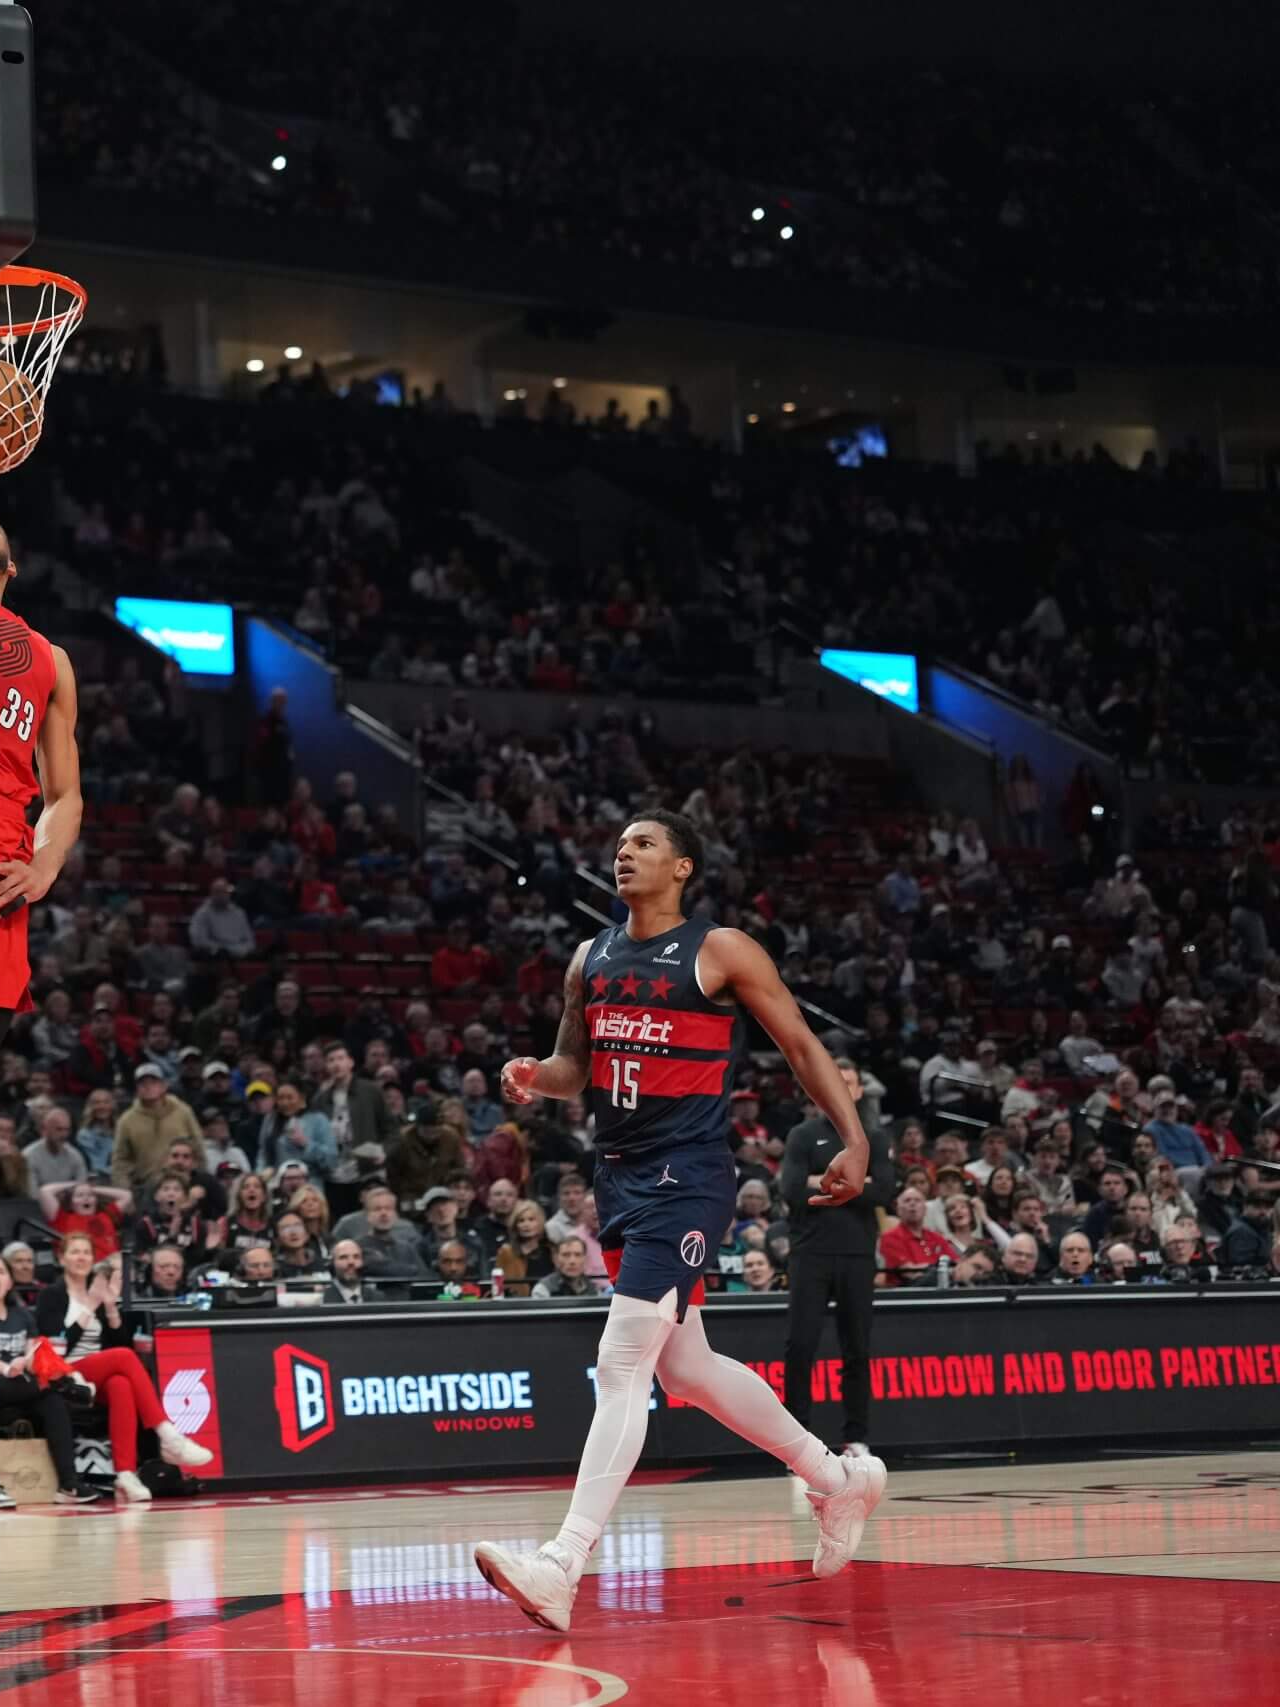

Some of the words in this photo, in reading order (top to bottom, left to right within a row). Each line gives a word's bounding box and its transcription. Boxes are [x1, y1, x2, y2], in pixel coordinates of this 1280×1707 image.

[0, 685, 36, 743] 33
[610, 1058, 641, 1111] 15
[341, 1370, 534, 1416] BRIGHTSIDE
[1004, 1351, 1066, 1396] AND
[1070, 1347, 1156, 1393] DOOR
[432, 1414, 535, 1433] WINDOWS
